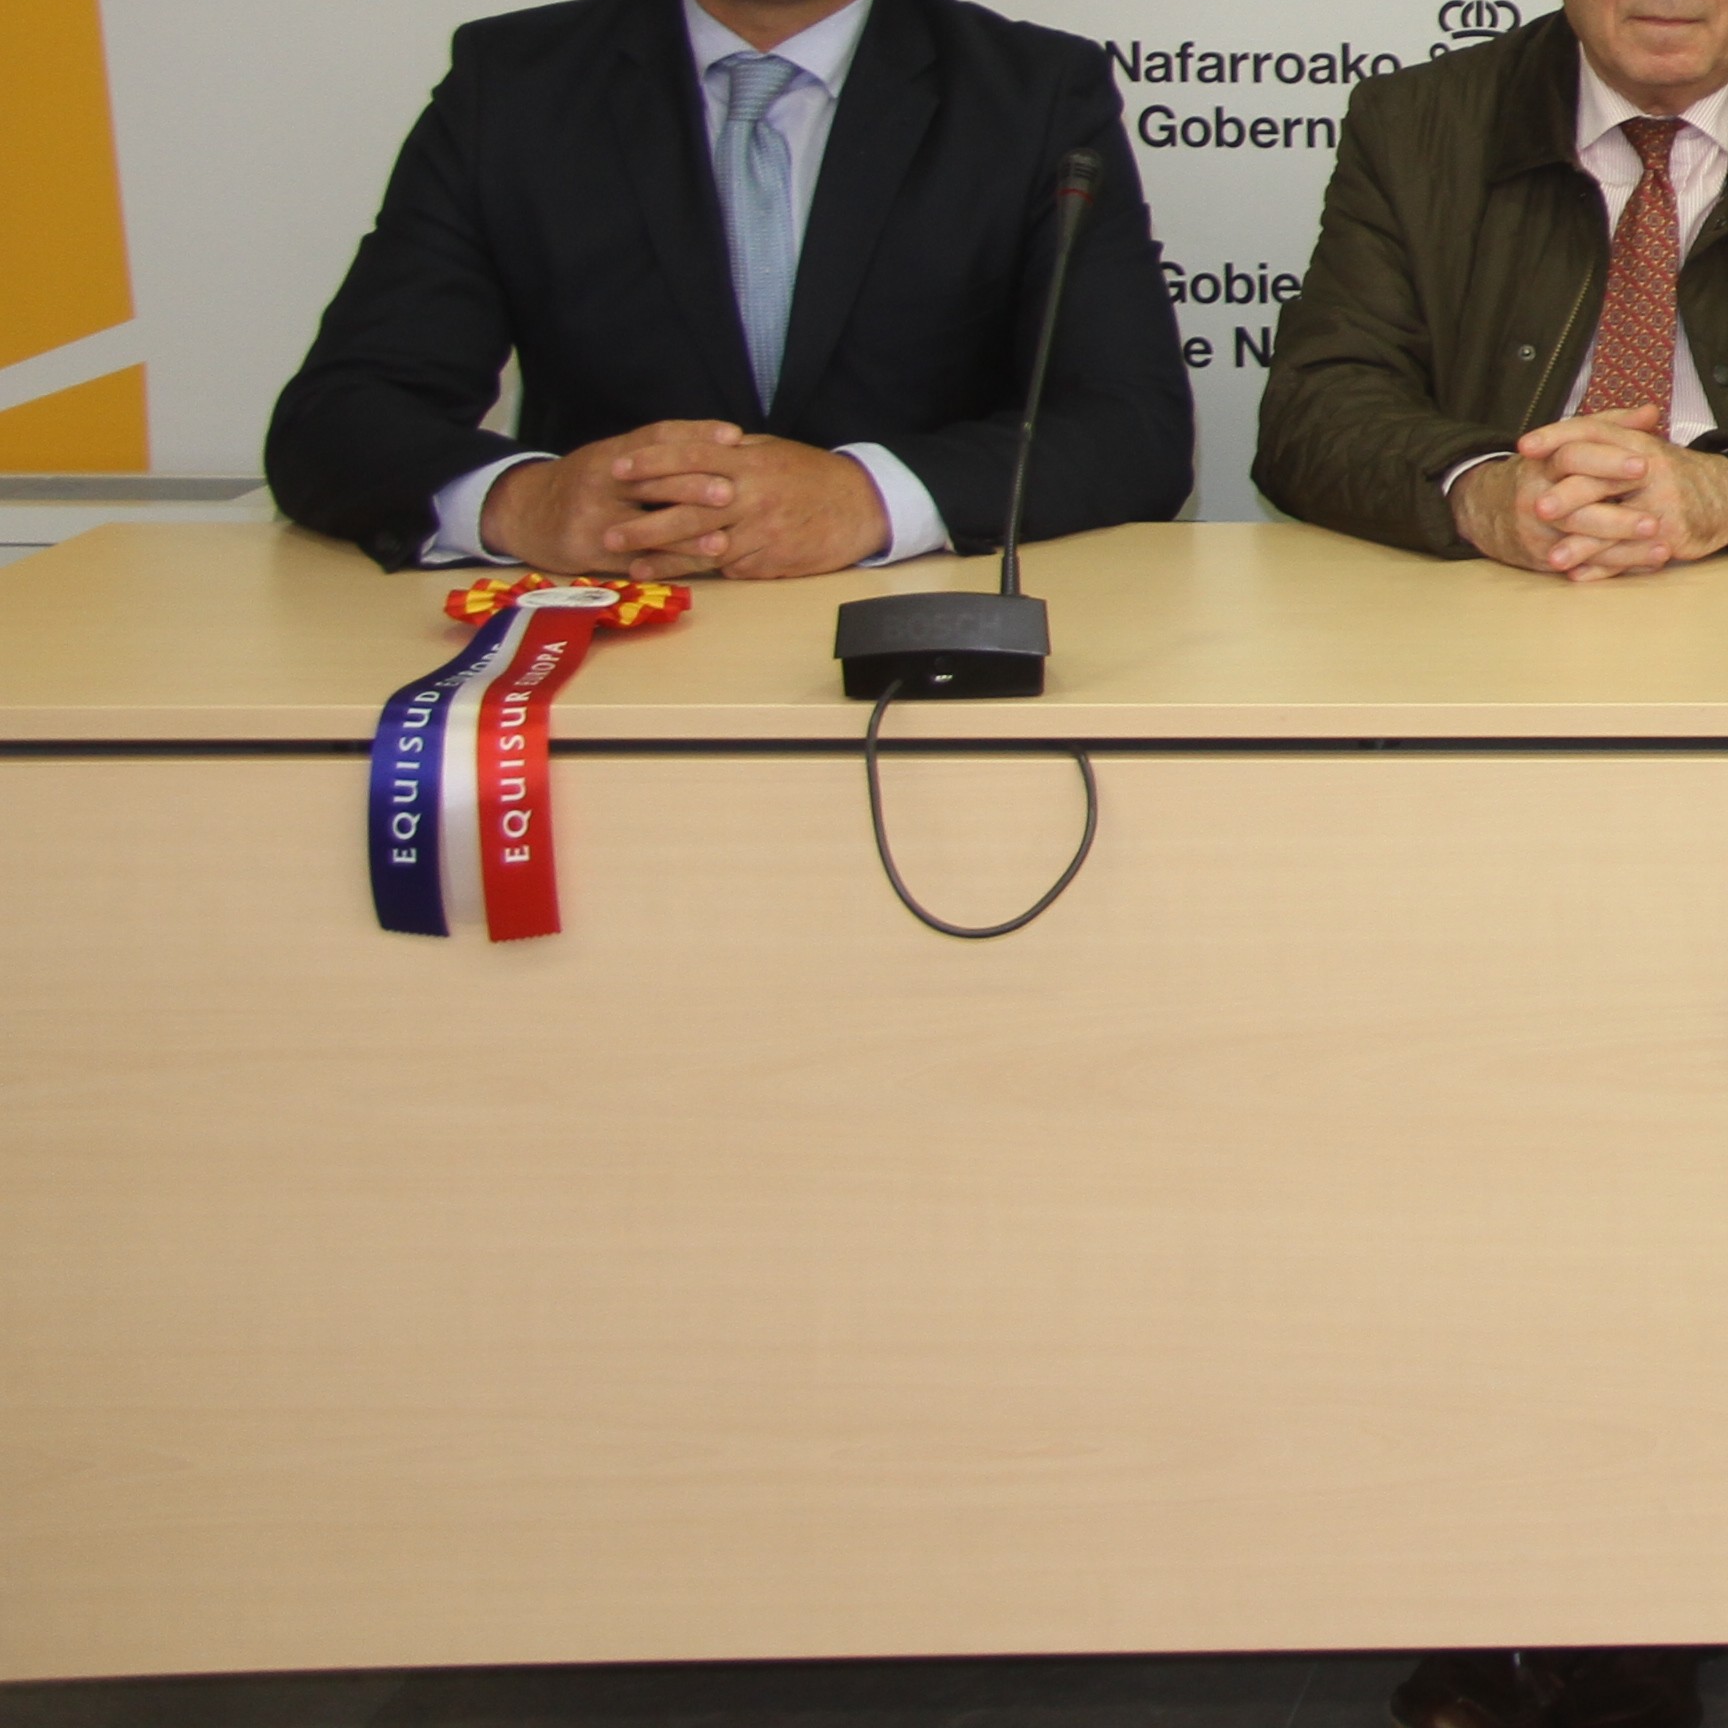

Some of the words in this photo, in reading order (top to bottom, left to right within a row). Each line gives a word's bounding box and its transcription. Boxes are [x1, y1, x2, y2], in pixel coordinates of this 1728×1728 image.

[1105, 41, 1401, 83] Nafarroako
[1138, 105, 1338, 148] Gobern
[1160, 261, 1302, 304] Gobie
[514, 640, 568, 686] EUROPA
[392, 690, 440, 864] EQUISUD
[500, 690, 533, 864] EQUISUR
